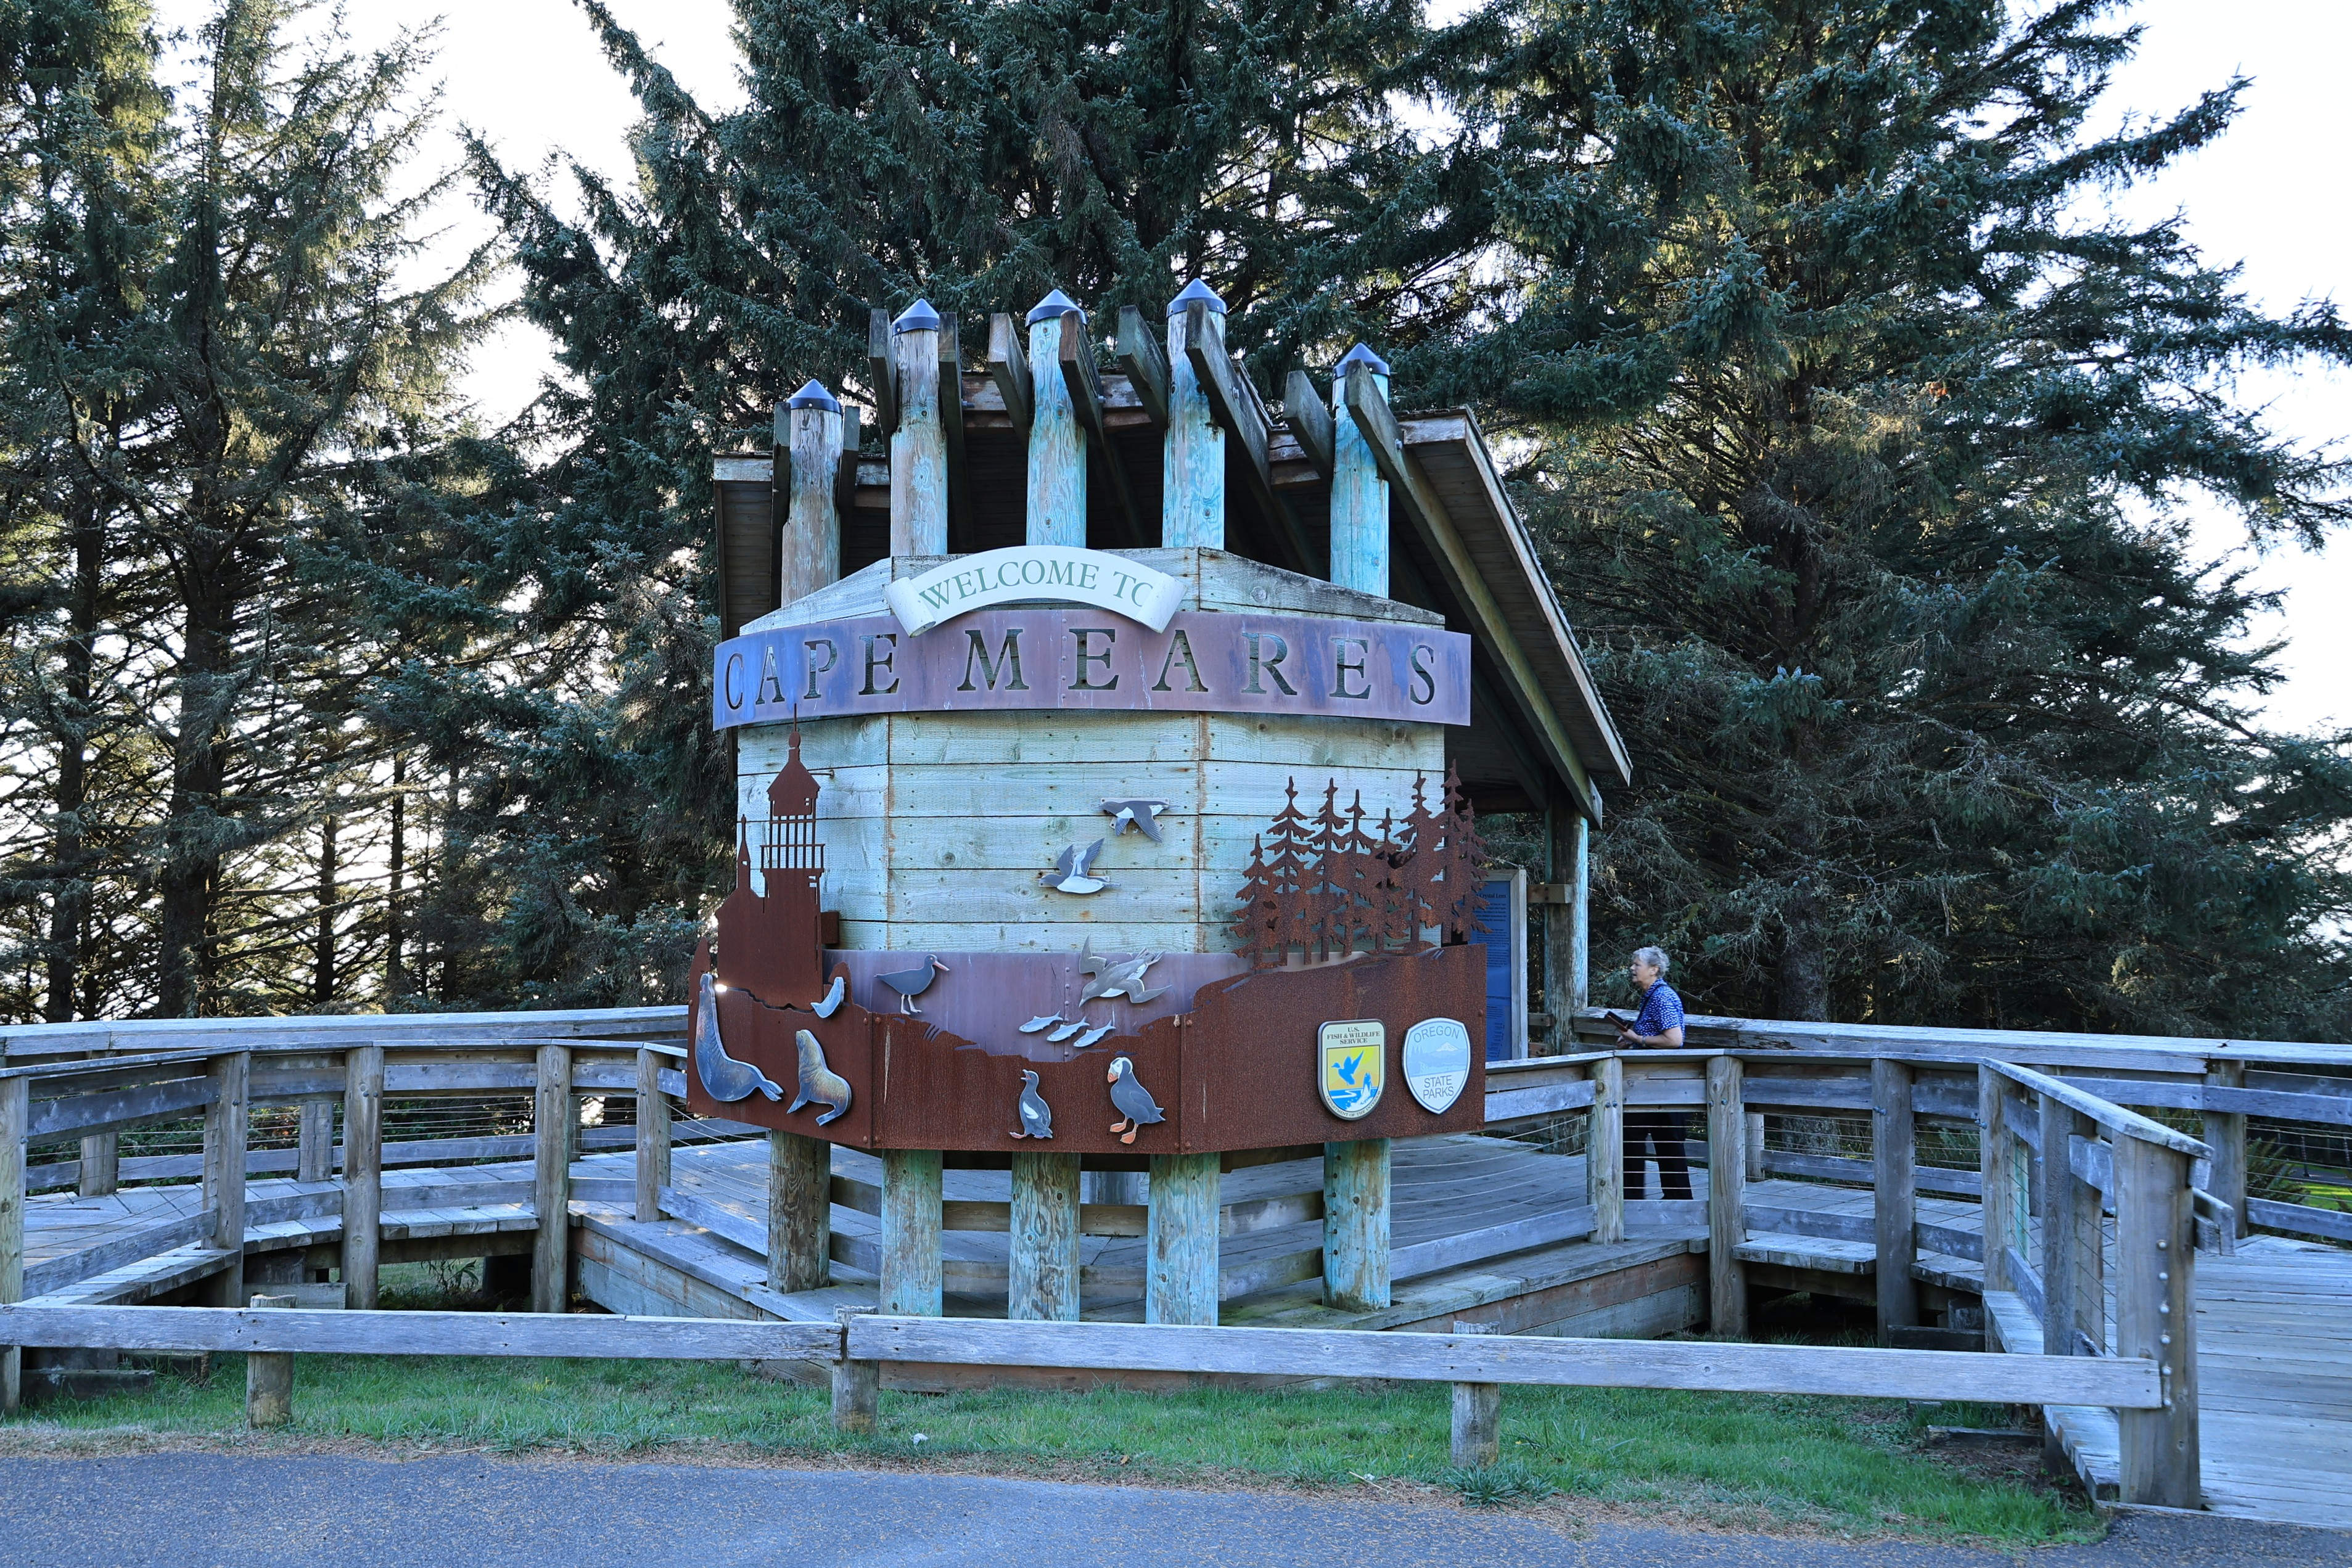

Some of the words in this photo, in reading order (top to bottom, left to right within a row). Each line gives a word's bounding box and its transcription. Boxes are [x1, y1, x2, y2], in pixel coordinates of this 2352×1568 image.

[919, 560, 1100, 609] WELCOME
[725, 634, 900, 710] CAPE
[956, 628, 1436, 705] MEARES
[1413, 1025, 1460, 1043] OREGON
[1424, 1075, 1452, 1088] STATE
[1423, 1086, 1454, 1100] PARKS
